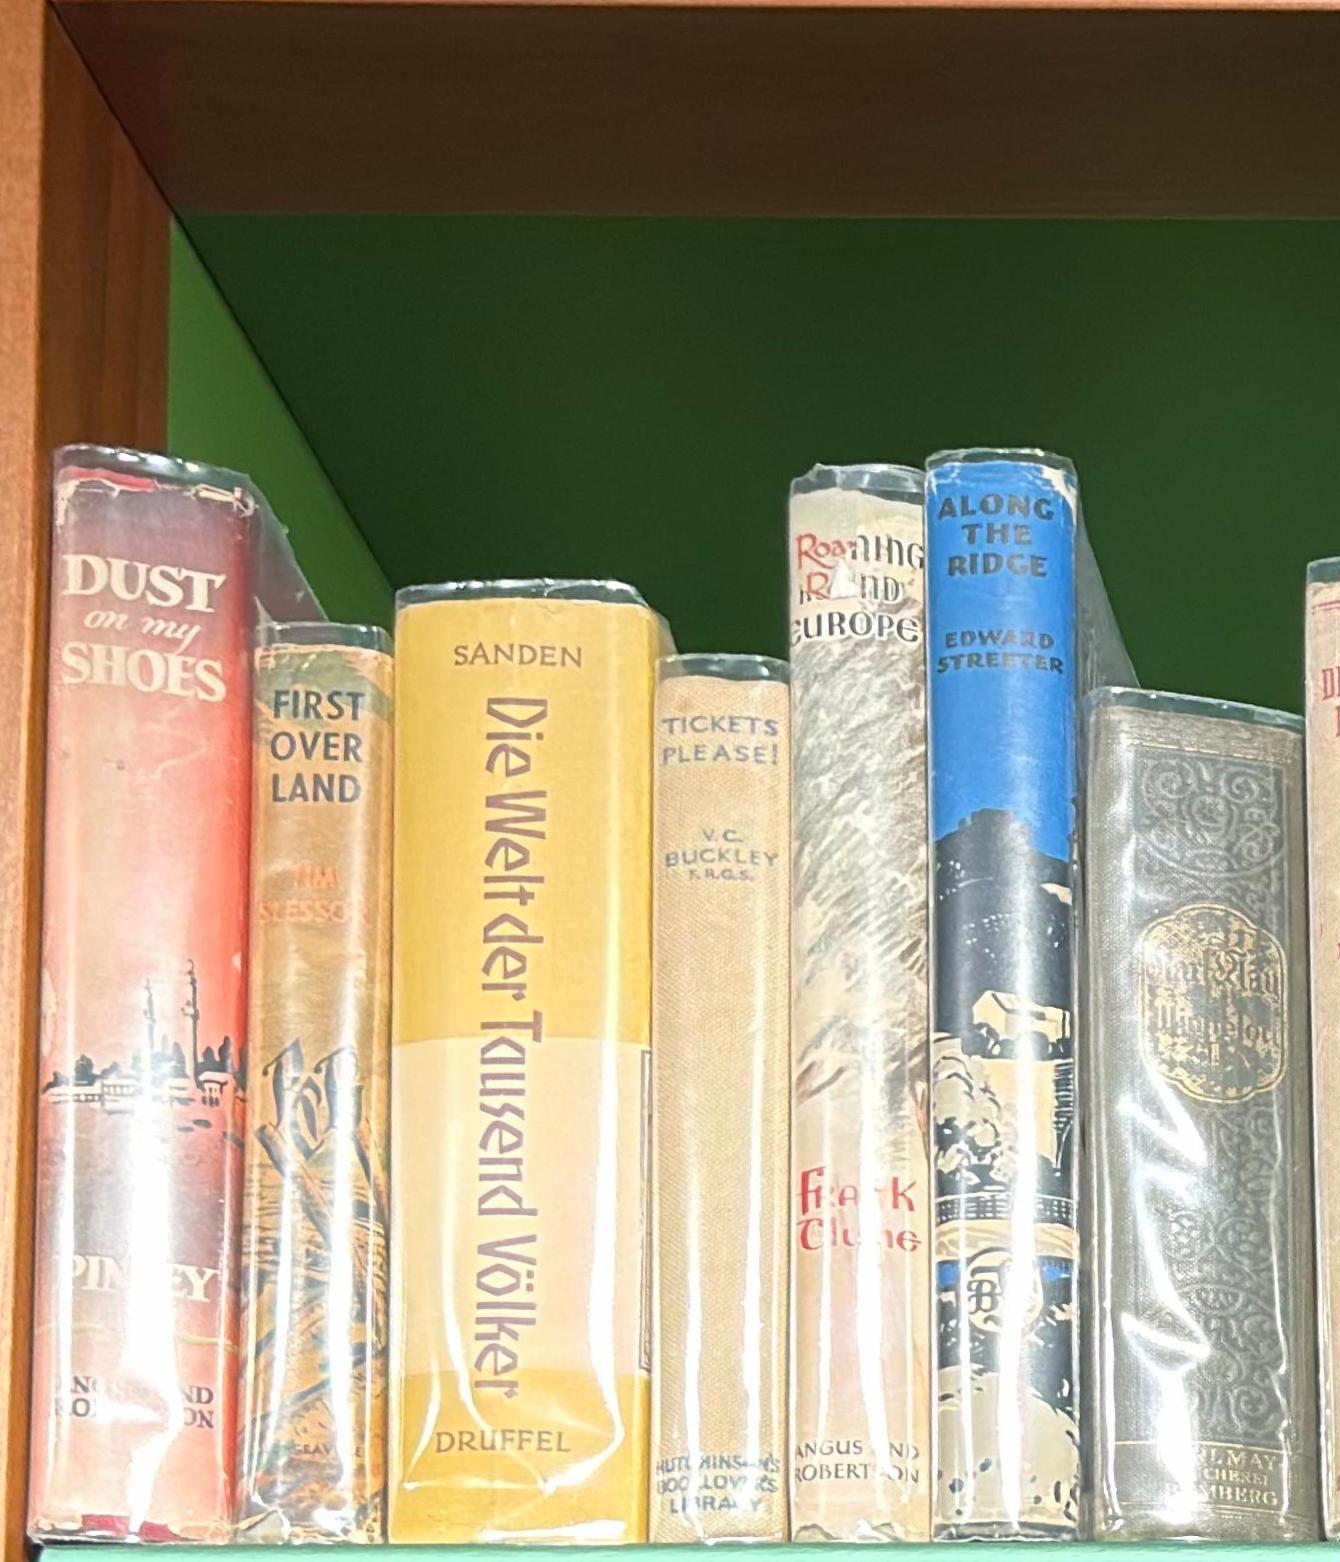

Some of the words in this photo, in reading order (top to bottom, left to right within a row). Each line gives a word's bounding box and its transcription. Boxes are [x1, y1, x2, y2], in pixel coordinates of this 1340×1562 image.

[938, 494, 1055, 521] ALONG
[961, 522, 1032, 545] THE
[948, 551, 1048, 578] RIDGE
[62, 554, 226, 613] DUST
[85, 610, 128, 631] on
[143, 616, 202, 654] my
[945, 630, 1055, 650] EDWARD
[454, 642, 582, 668] SANDEN
[937, 652, 1064, 675] STREETER
[61, 641, 227, 703] SHOES
[273, 689, 366, 722] FIRST
[485, 697, 548, 778] Die
[662, 715, 779, 737] TICKETS
[270, 730, 363, 763] OVER
[662, 743, 778, 766] PLEASE!
[272, 773, 363, 803] LAND
[484, 790, 548, 906] Welt
[665, 849, 779, 867] BUCKLEY
[481, 913, 544, 1002] der
[477, 1010, 543, 1217] Tausend
[54, 1254, 221, 1303] PINEY
[474, 1234, 538, 1399] Völker
[435, 1430, 571, 1453] DRUFFEL
[795, 1462, 919, 1484] ROBERTON
[1226, 1449, 1277, 1471] MAY
